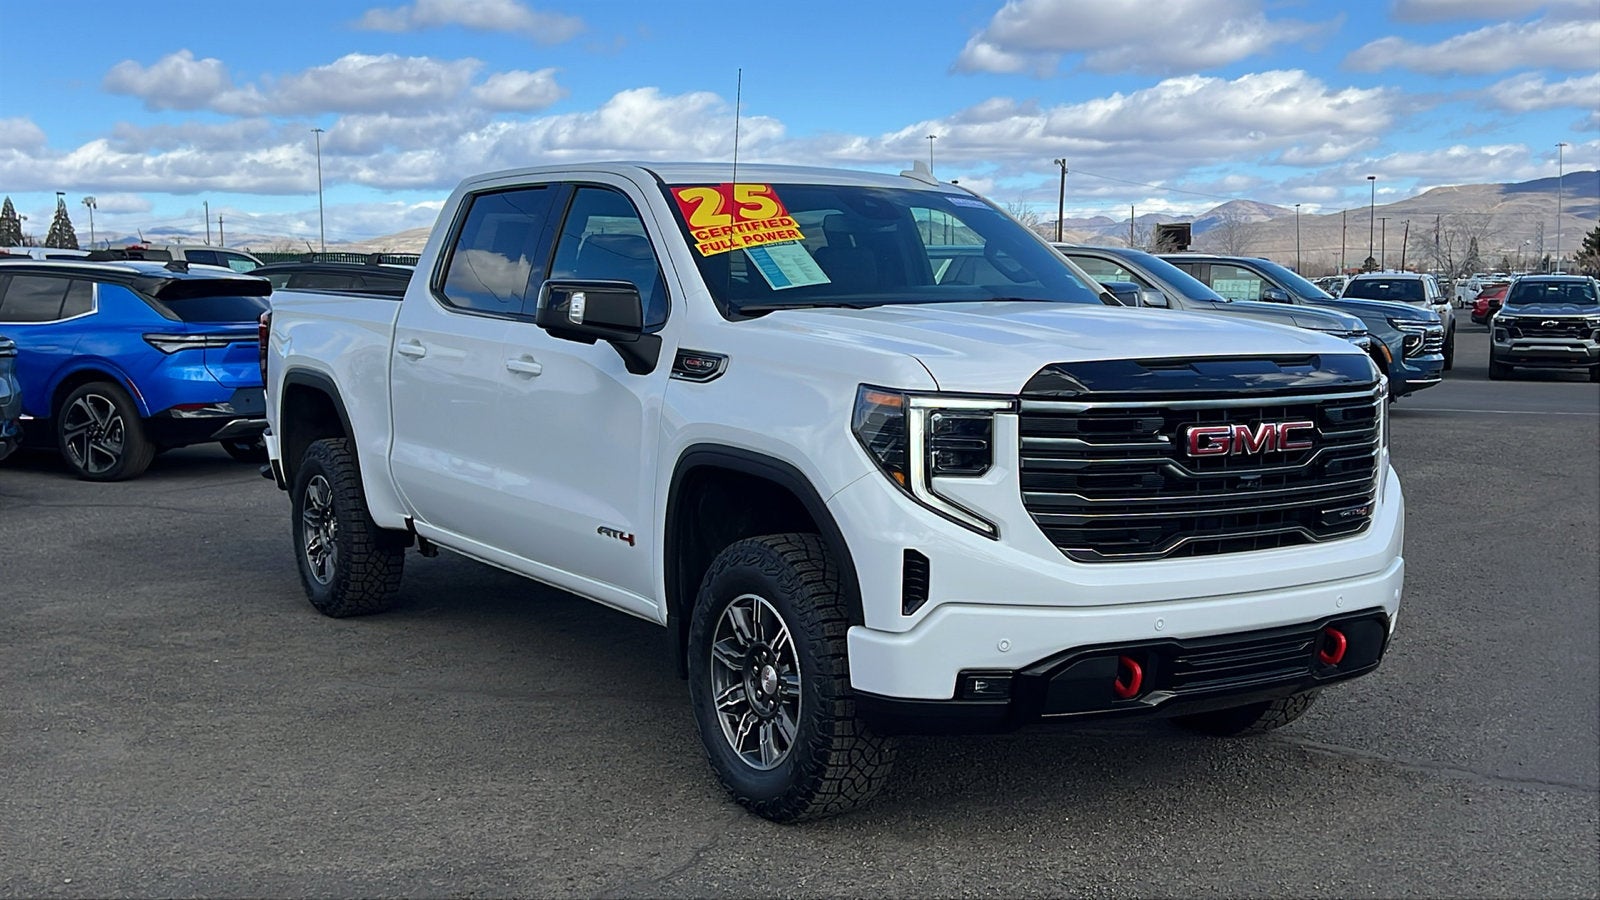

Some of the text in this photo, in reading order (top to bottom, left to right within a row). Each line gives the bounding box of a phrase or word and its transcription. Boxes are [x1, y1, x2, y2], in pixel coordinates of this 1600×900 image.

[678, 184, 783, 228] 25
[695, 218, 794, 241] CERTIFIED
[700, 239, 740, 254] FULL
[743, 229, 799, 245] POWER
[1187, 421, 1314, 457] GMC
[597, 526, 635, 547] AT4
